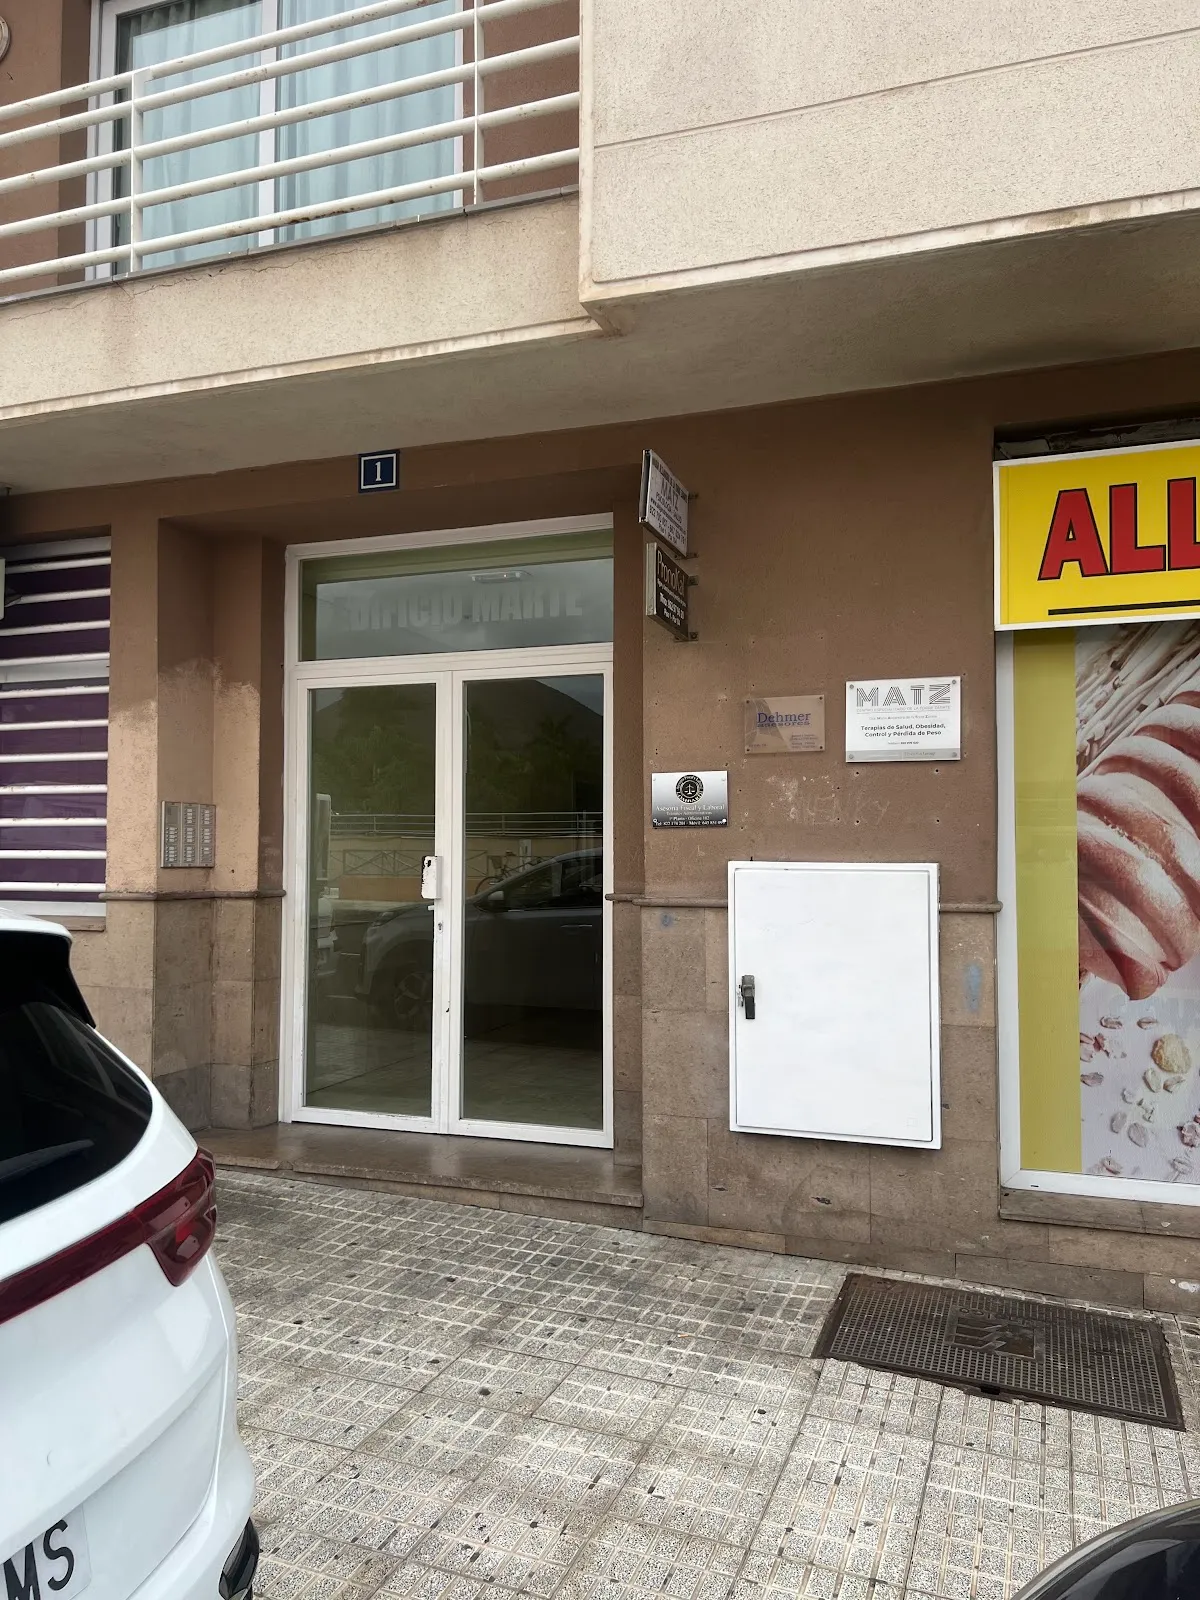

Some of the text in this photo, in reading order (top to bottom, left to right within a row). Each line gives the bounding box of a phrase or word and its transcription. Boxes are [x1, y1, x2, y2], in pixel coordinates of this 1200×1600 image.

[375, 461, 382, 481] 1
[660, 477, 679, 511] MATZ
[1037, 476, 1200, 581] ALL
[857, 683, 951, 707] MATZ
[757, 712, 811, 723] Dehmer
[702, 803, 726, 811] Laboral
[3, 1519, 75, 1600] MS
